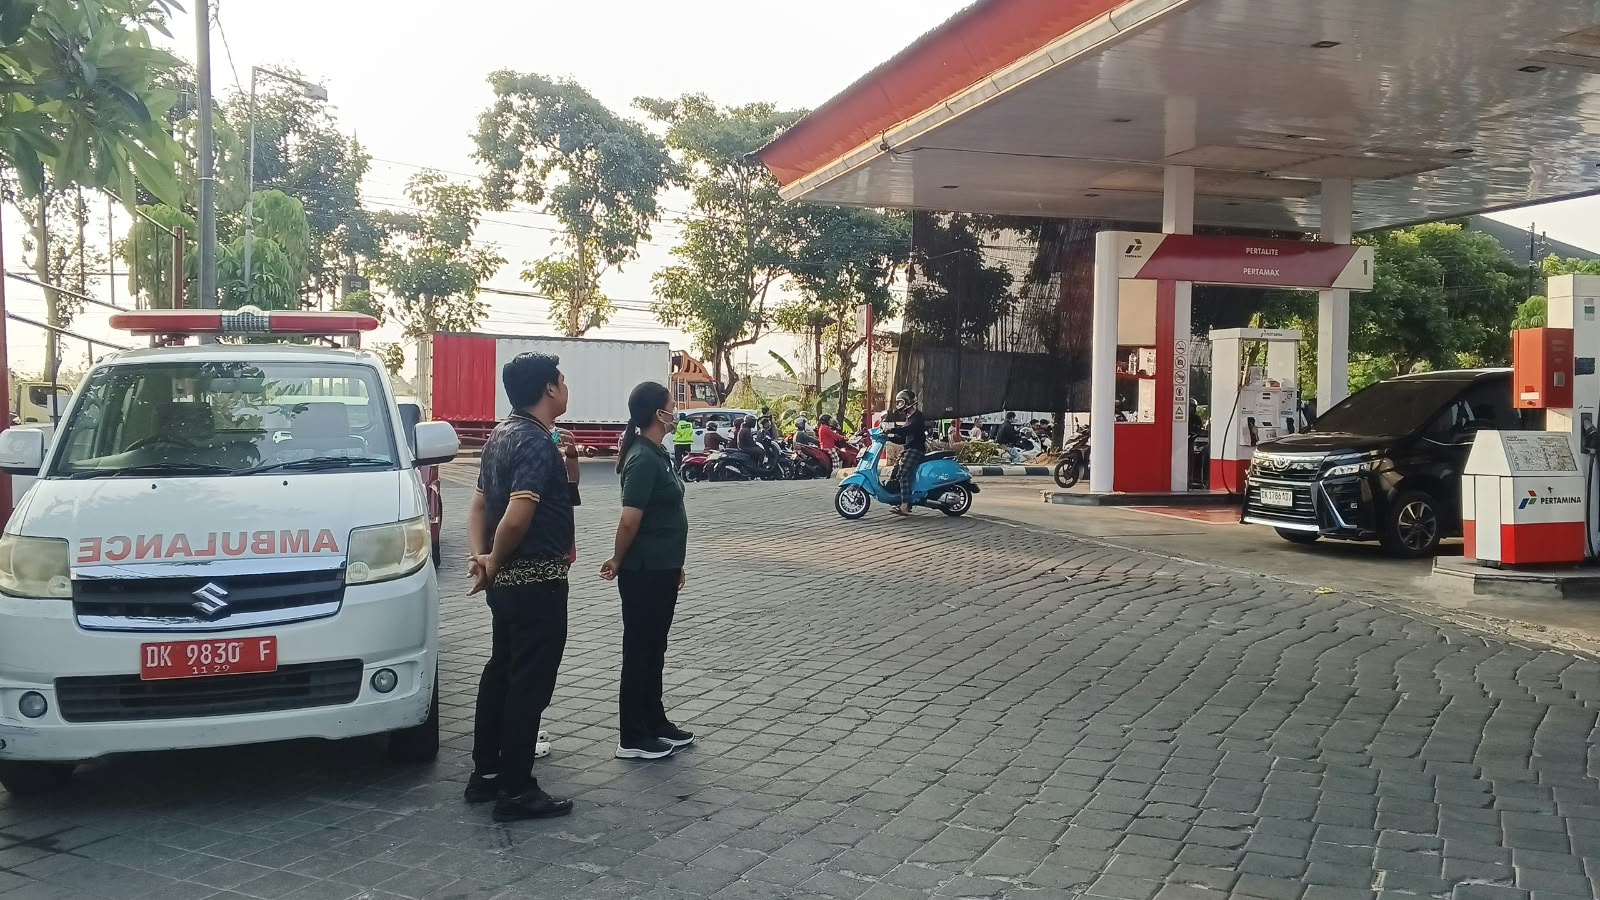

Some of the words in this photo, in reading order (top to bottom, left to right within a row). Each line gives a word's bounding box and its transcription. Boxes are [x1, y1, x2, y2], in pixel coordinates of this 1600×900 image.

[1245, 247, 1279, 256] PERTALITE
[1243, 268, 1280, 277] PERTAMAX
[1540, 497, 1582, 505] PERTAMINA
[146, 645, 172, 668] DK
[186, 642, 240, 666] 9830
[259, 640, 272, 662] F
[192, 666, 207, 675] 11
[214, 664, 230, 673] 29
